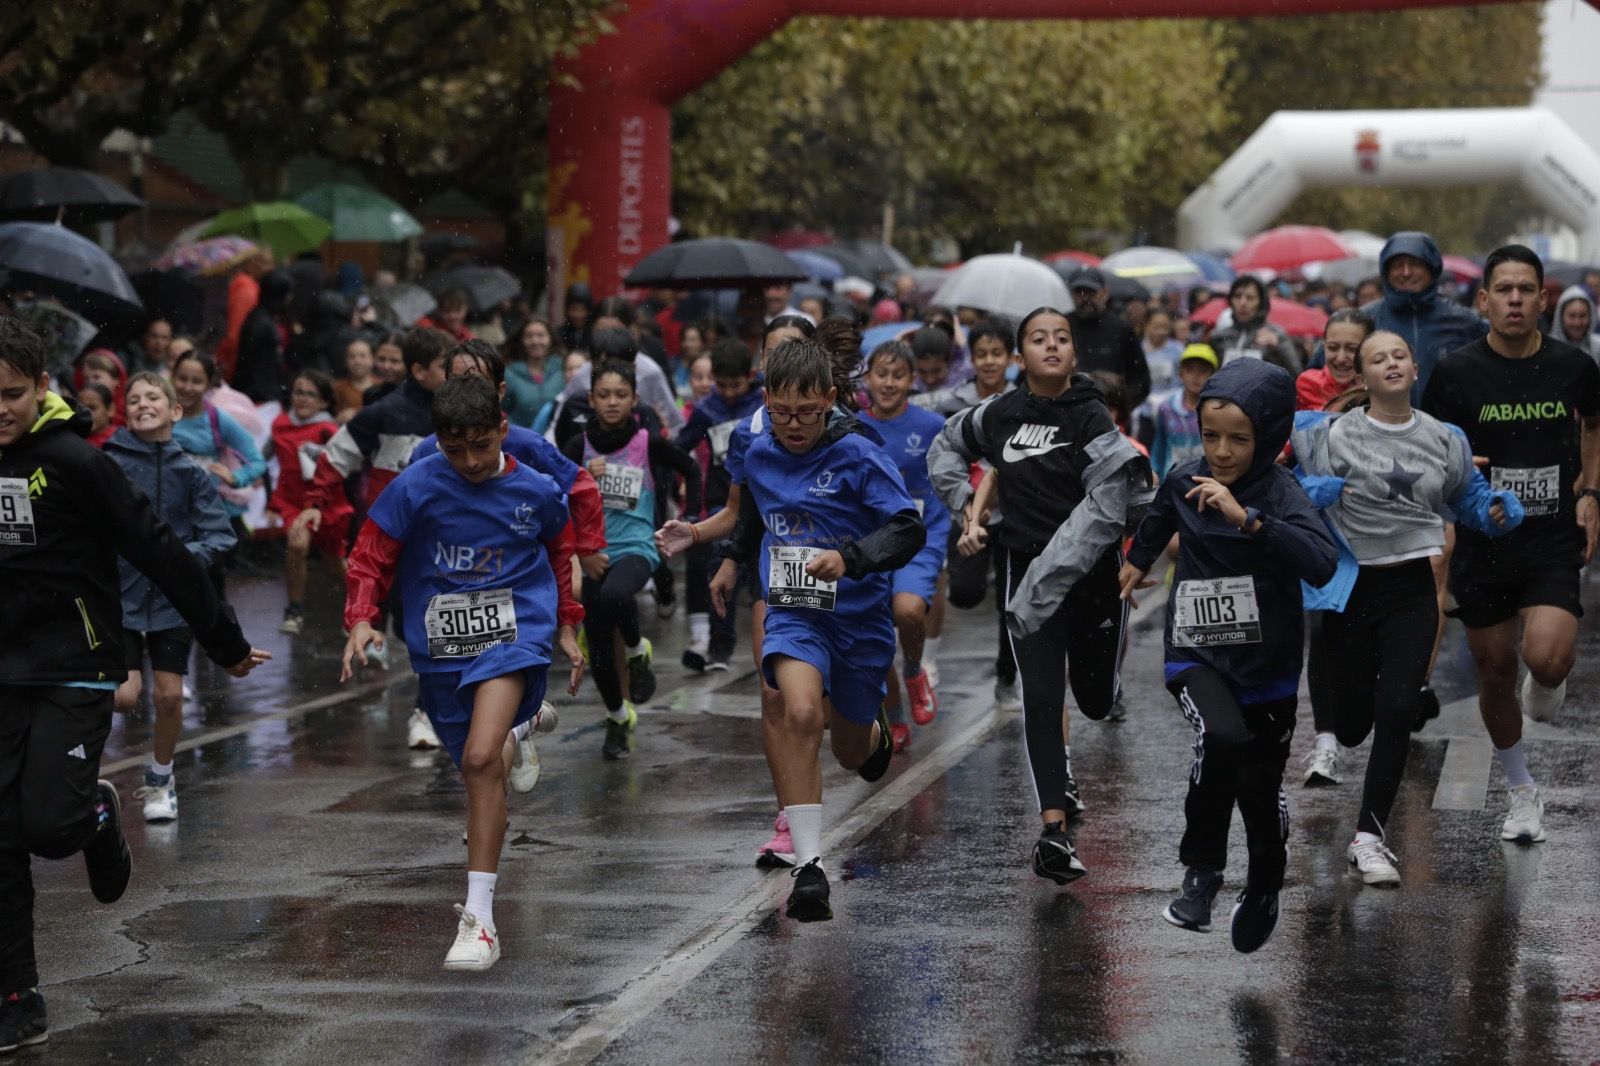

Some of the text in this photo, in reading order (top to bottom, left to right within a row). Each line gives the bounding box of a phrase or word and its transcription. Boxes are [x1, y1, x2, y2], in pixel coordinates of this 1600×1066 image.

[617, 116, 645, 254] DEPORTES
[1011, 423, 1060, 448] NIKE
[434, 541, 505, 573] NB21
[439, 603, 501, 636] 3058
[1193, 595, 1237, 625] 1103
[462, 639, 502, 652] HYUNDAI
[1206, 631, 1246, 640] HYUNDAI
